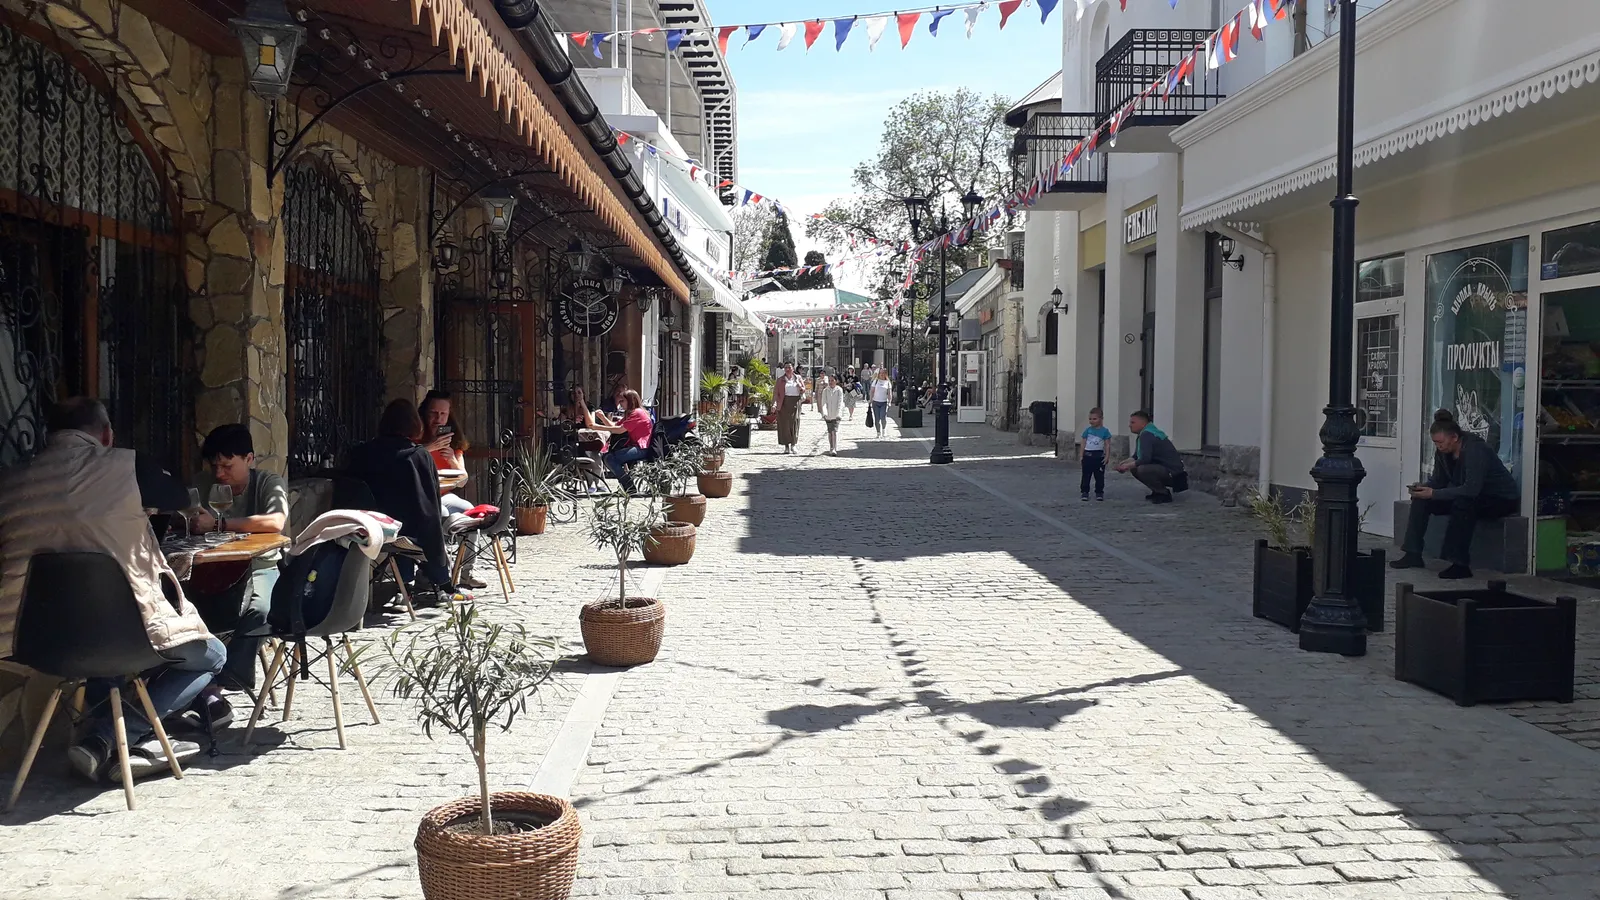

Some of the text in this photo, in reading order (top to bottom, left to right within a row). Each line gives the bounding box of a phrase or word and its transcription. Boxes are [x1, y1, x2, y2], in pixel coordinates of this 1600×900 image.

[1124, 203, 1157, 245] ГЕНБАНК
[573, 279, 601, 289] ПИЦЦА
[1451, 283, 1472, 316] АЛУПКА
[1476, 282, 1497, 312] КРЫМЪ
[559, 300, 583, 334] ЧЕБУРЕКИ
[601, 310, 616, 330] КОФЕ
[1447, 340, 1500, 371] ПРОДУКТЫ
